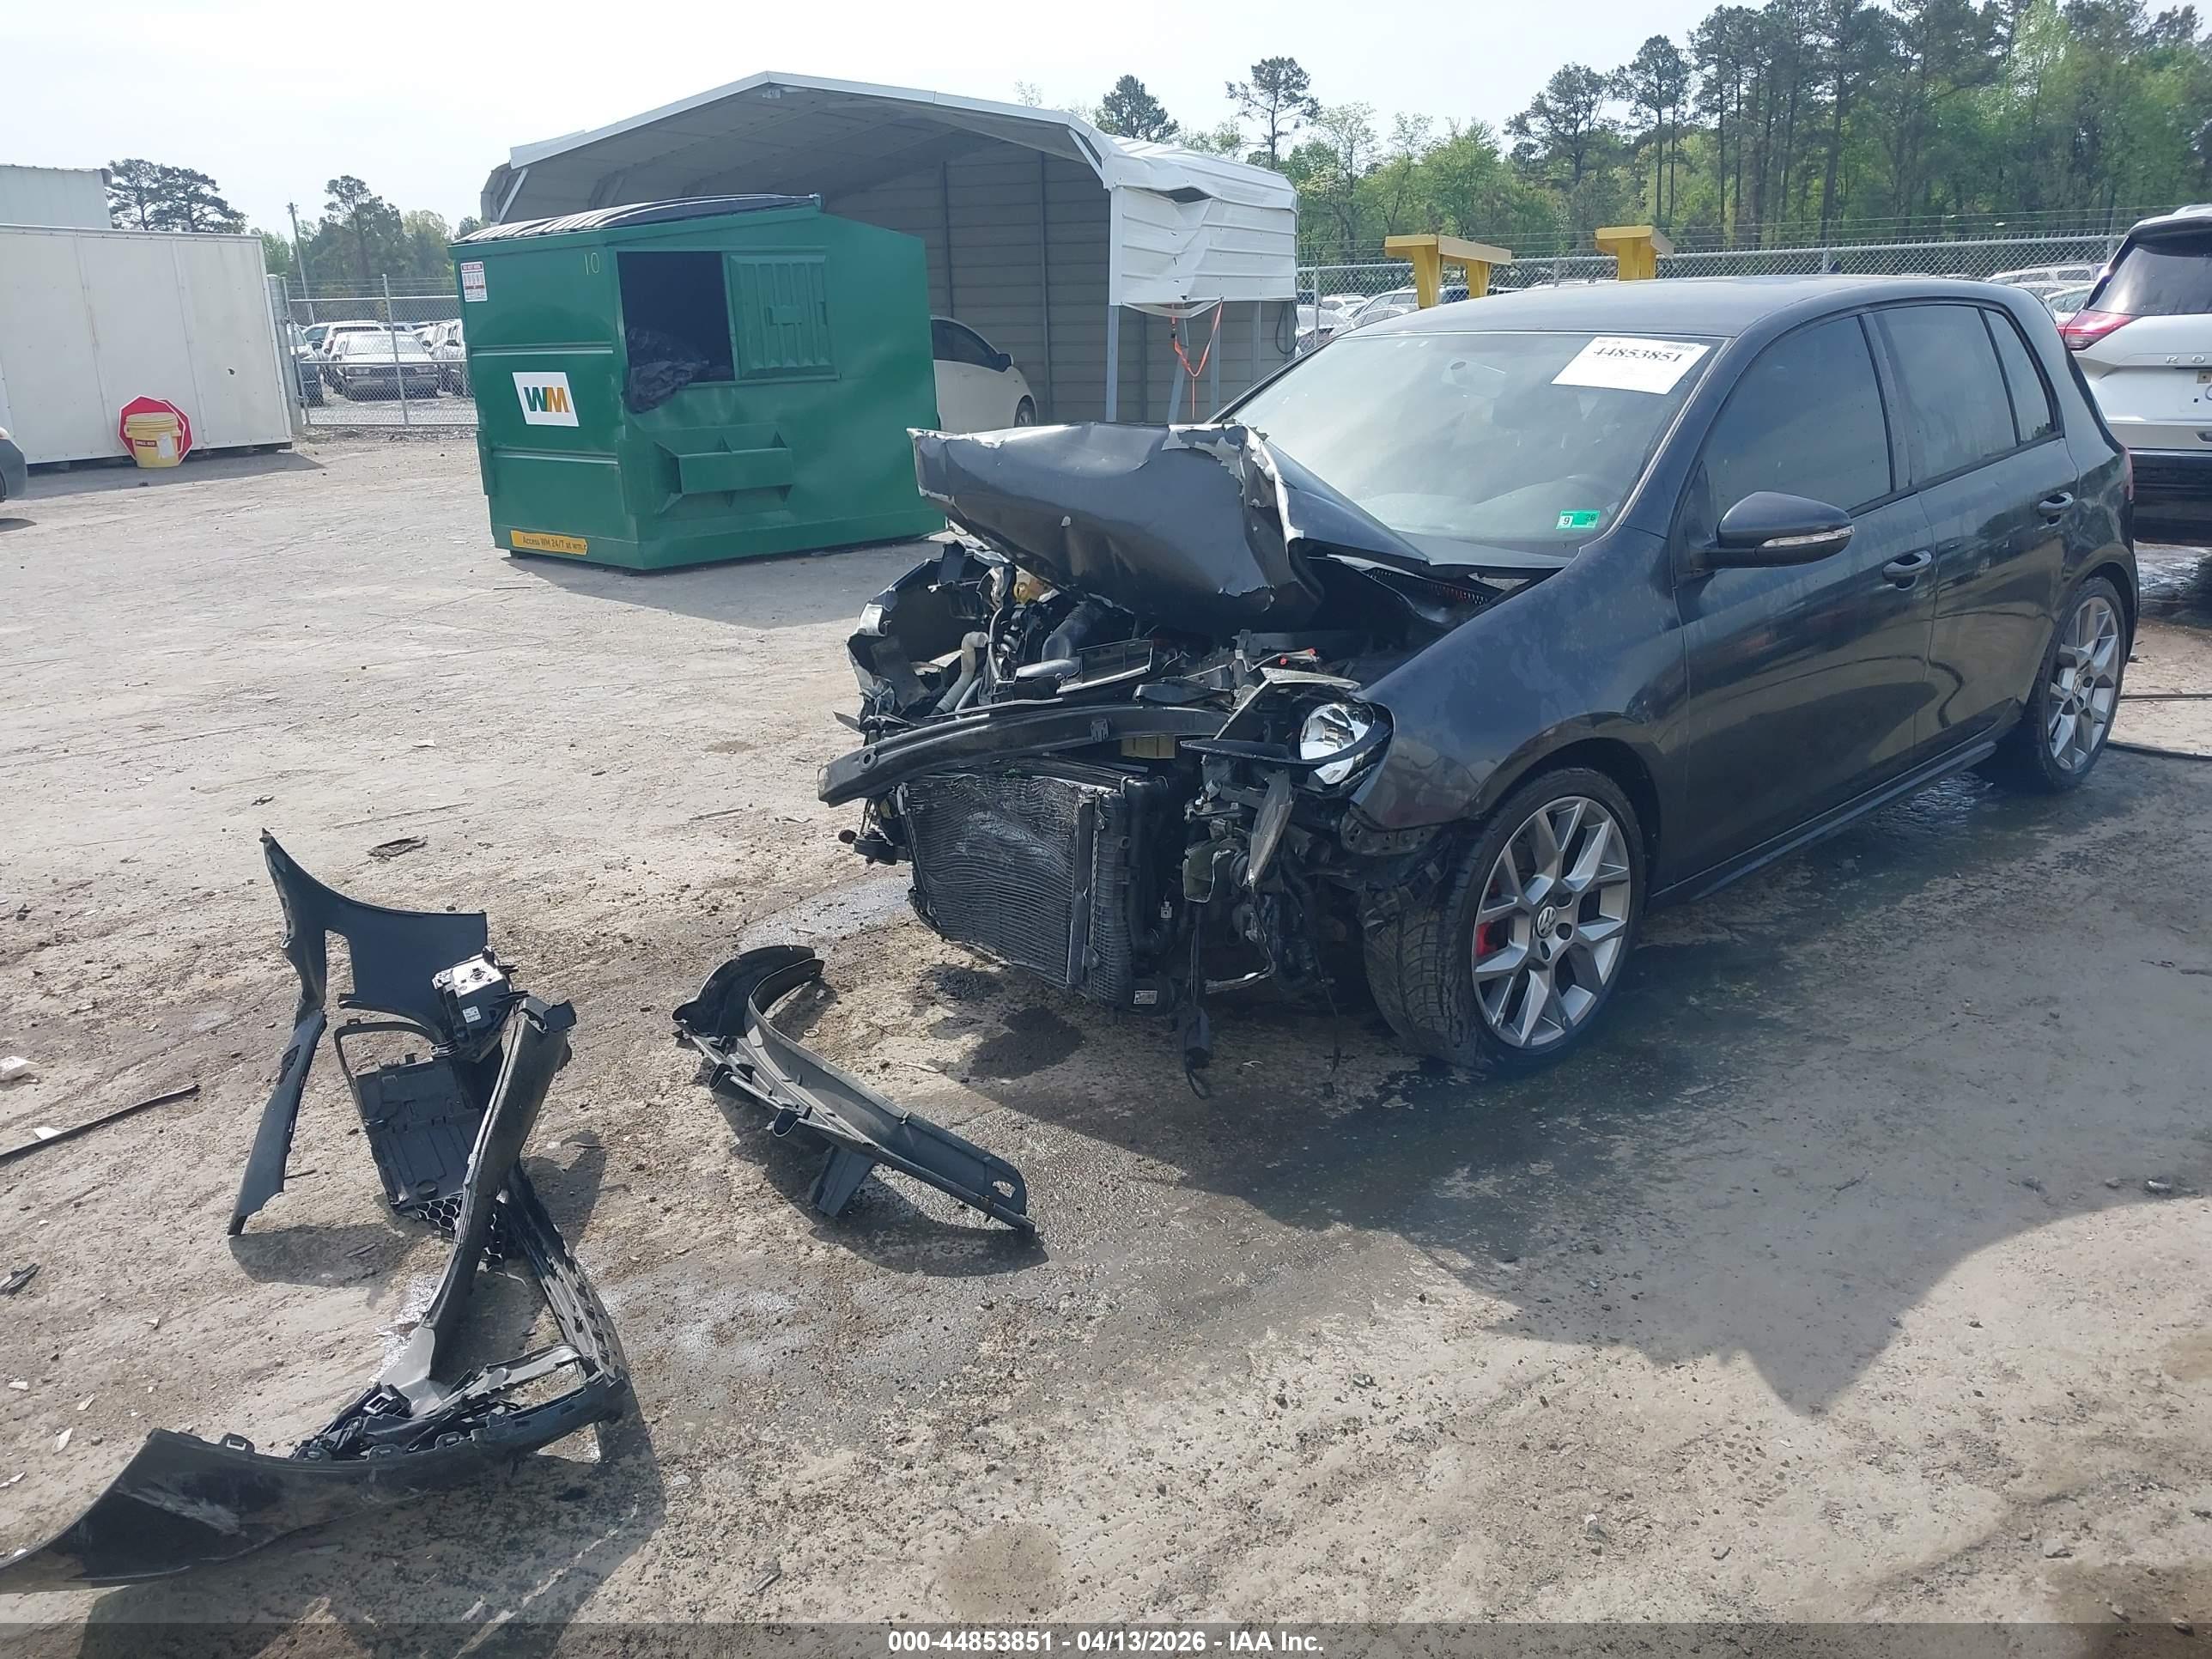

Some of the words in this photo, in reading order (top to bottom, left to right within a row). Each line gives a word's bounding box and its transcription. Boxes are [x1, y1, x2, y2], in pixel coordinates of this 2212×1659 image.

[584, 252, 600, 275] 10
[1594, 347, 1683, 362] 44853851
[523, 386, 569, 413] WM
[522, 536, 540, 545] Access
[540, 537, 550, 547] WM
[551, 538, 564, 547] 24/7
